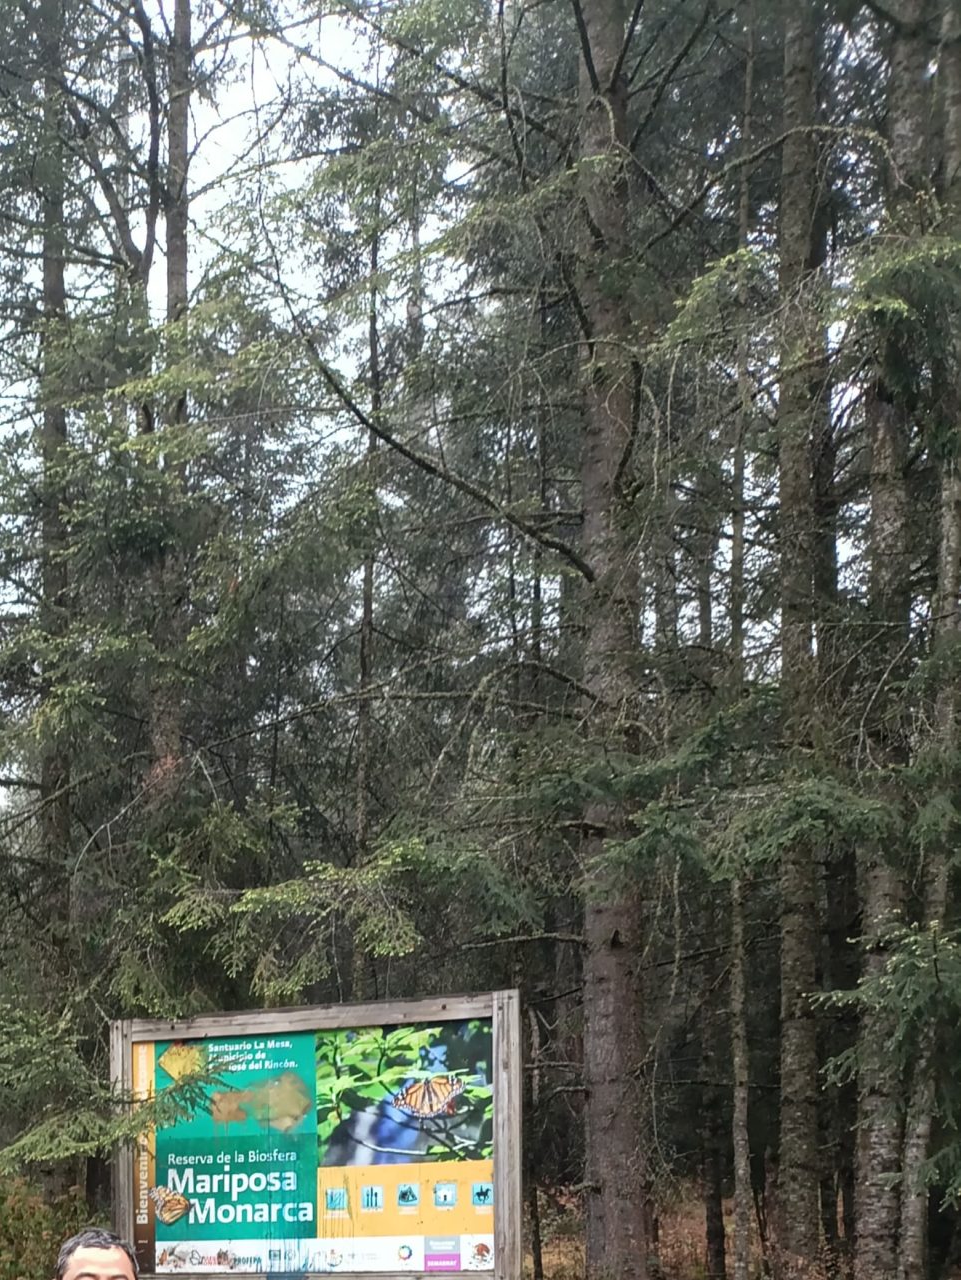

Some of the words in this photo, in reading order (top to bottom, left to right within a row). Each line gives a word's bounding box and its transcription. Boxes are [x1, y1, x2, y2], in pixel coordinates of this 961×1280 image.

[208, 1042, 252, 1053] Santuario
[254, 1041, 265, 1050] La
[267, 1040, 293, 1049] Mesa,
[255, 1051, 266, 1060] de
[248, 1061, 262, 1070] del
[264, 1059, 298, 1069] Rincón.
[167, 1153, 213, 1165] Reserva
[216, 1151, 231, 1164] de
[234, 1151, 245, 1163] la
[248, 1149, 297, 1162] Biosfera
[166, 1165, 297, 1201] Mariposa
[188, 1198, 314, 1224] Monarca
